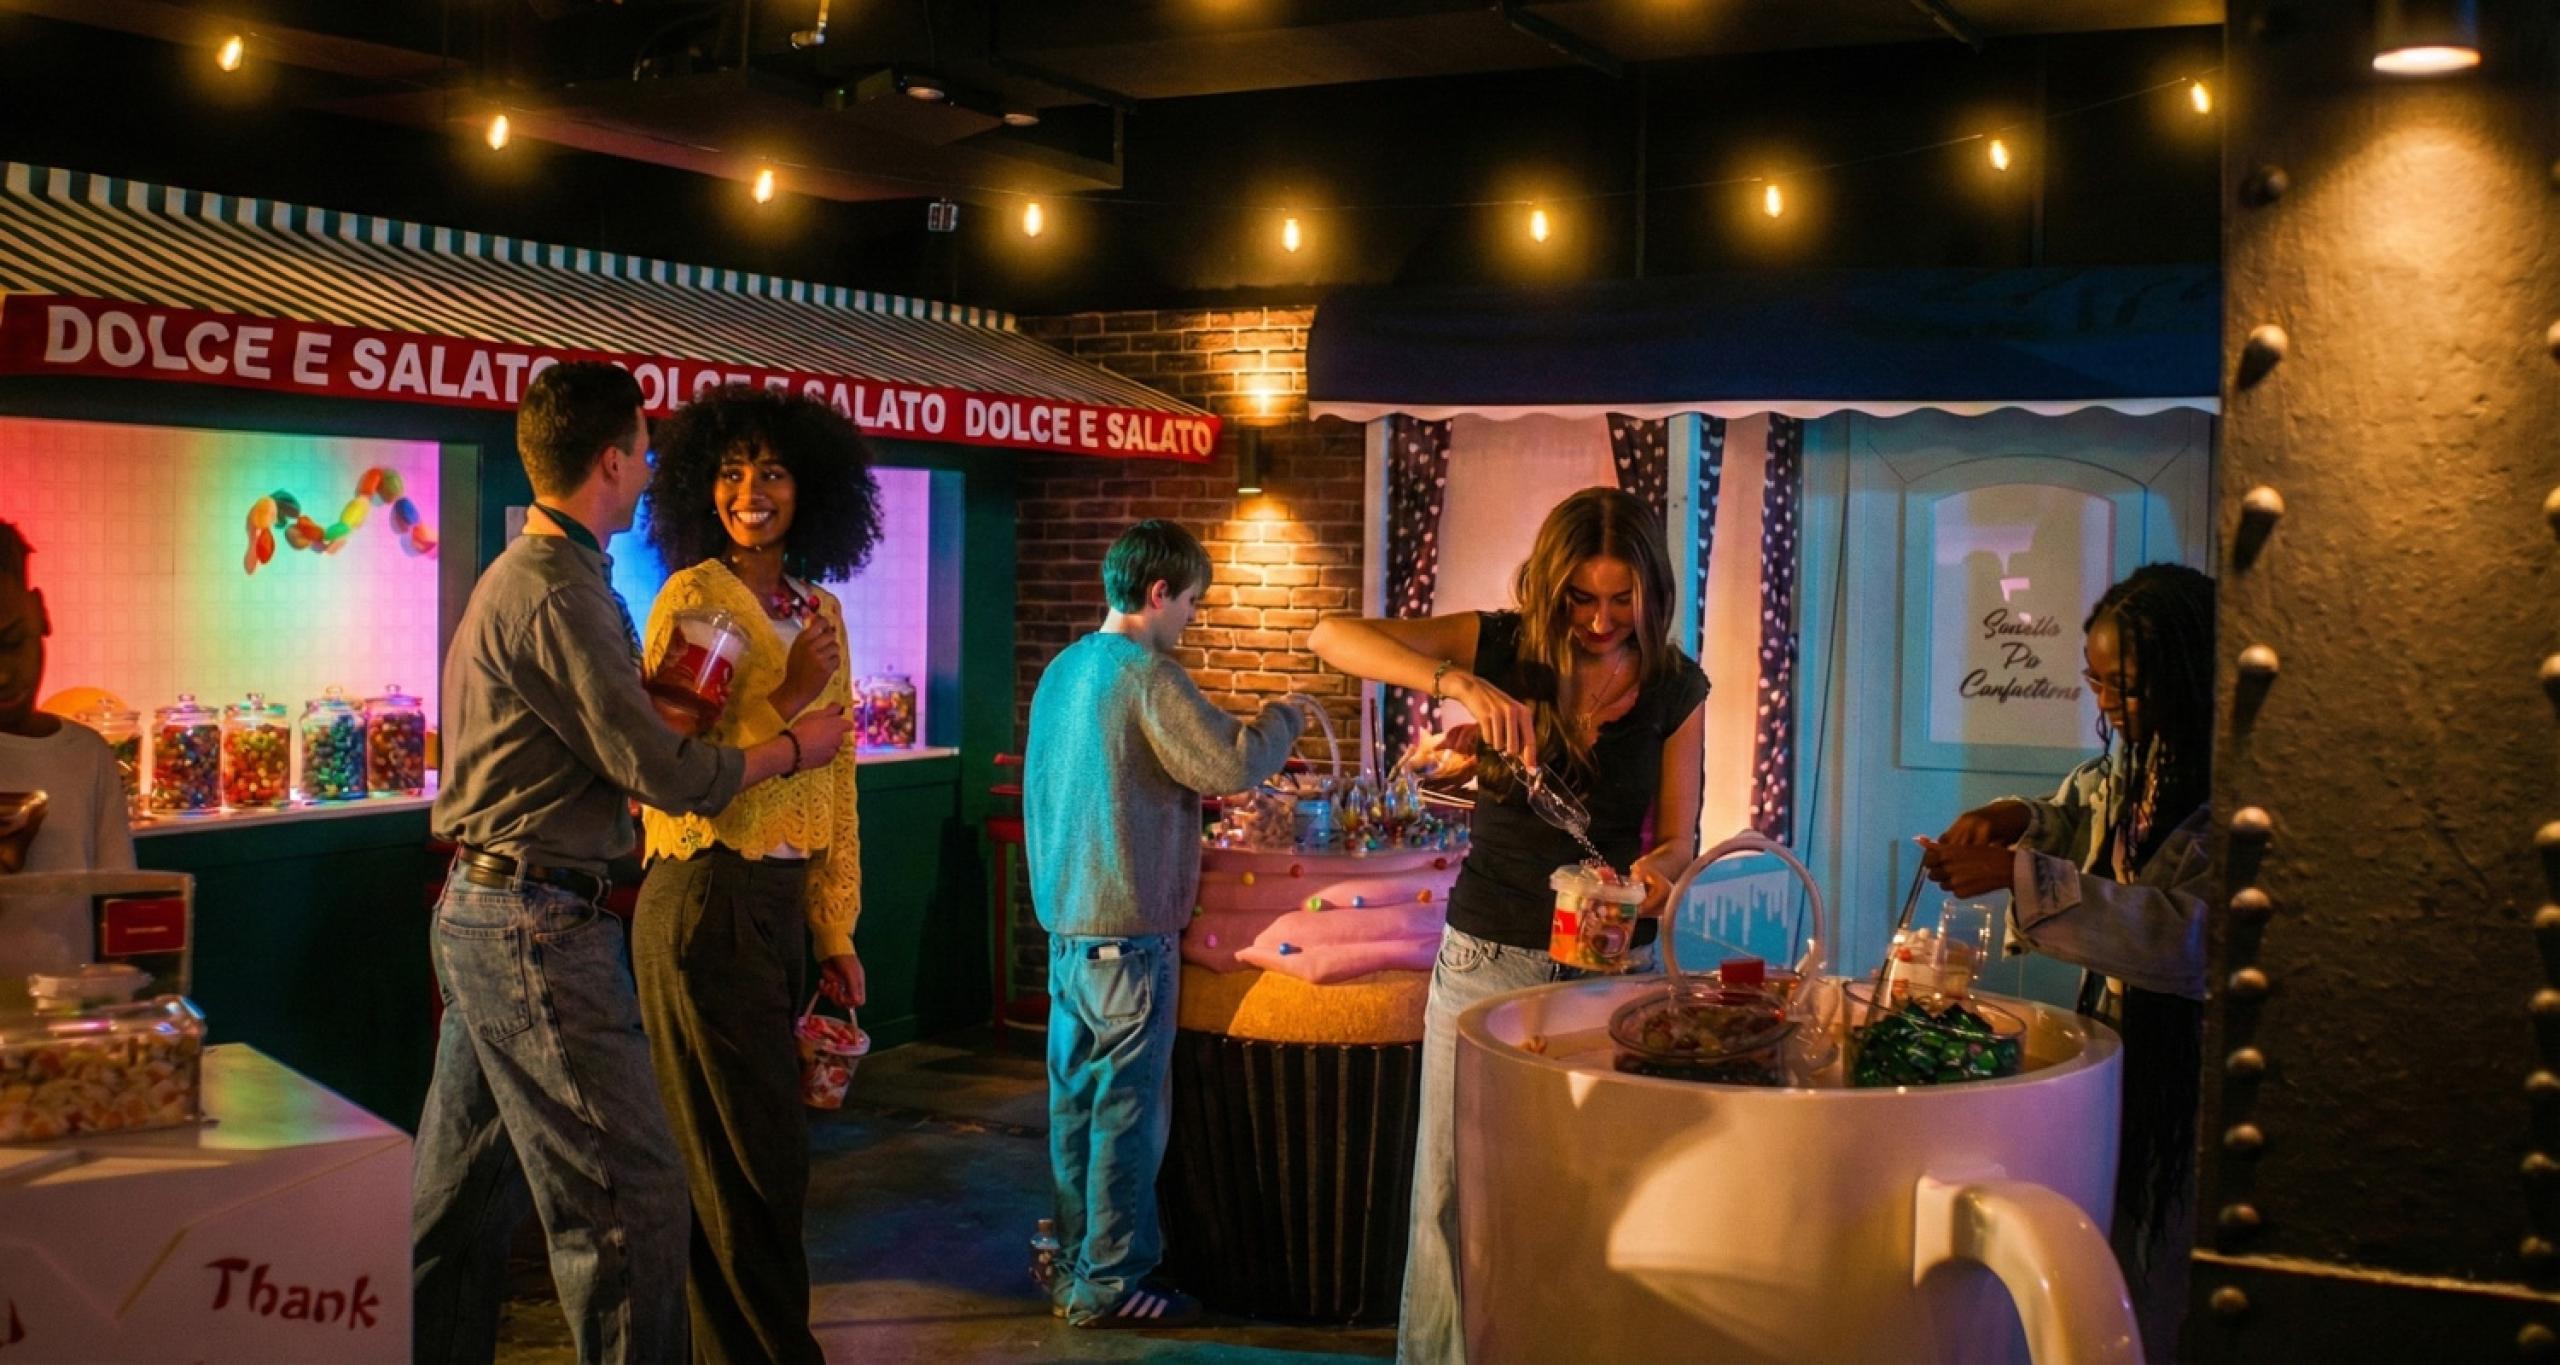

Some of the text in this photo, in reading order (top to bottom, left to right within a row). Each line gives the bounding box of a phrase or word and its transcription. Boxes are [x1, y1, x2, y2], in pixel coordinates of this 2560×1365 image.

[44, 305, 273, 380] DOLCE
[293, 332, 332, 386] E
[965, 398, 1072, 446] DOLCE
[1079, 411, 1100, 448] E
[1107, 413, 1213, 456] SALATO
[205, 1257, 380, 1330] Thank
